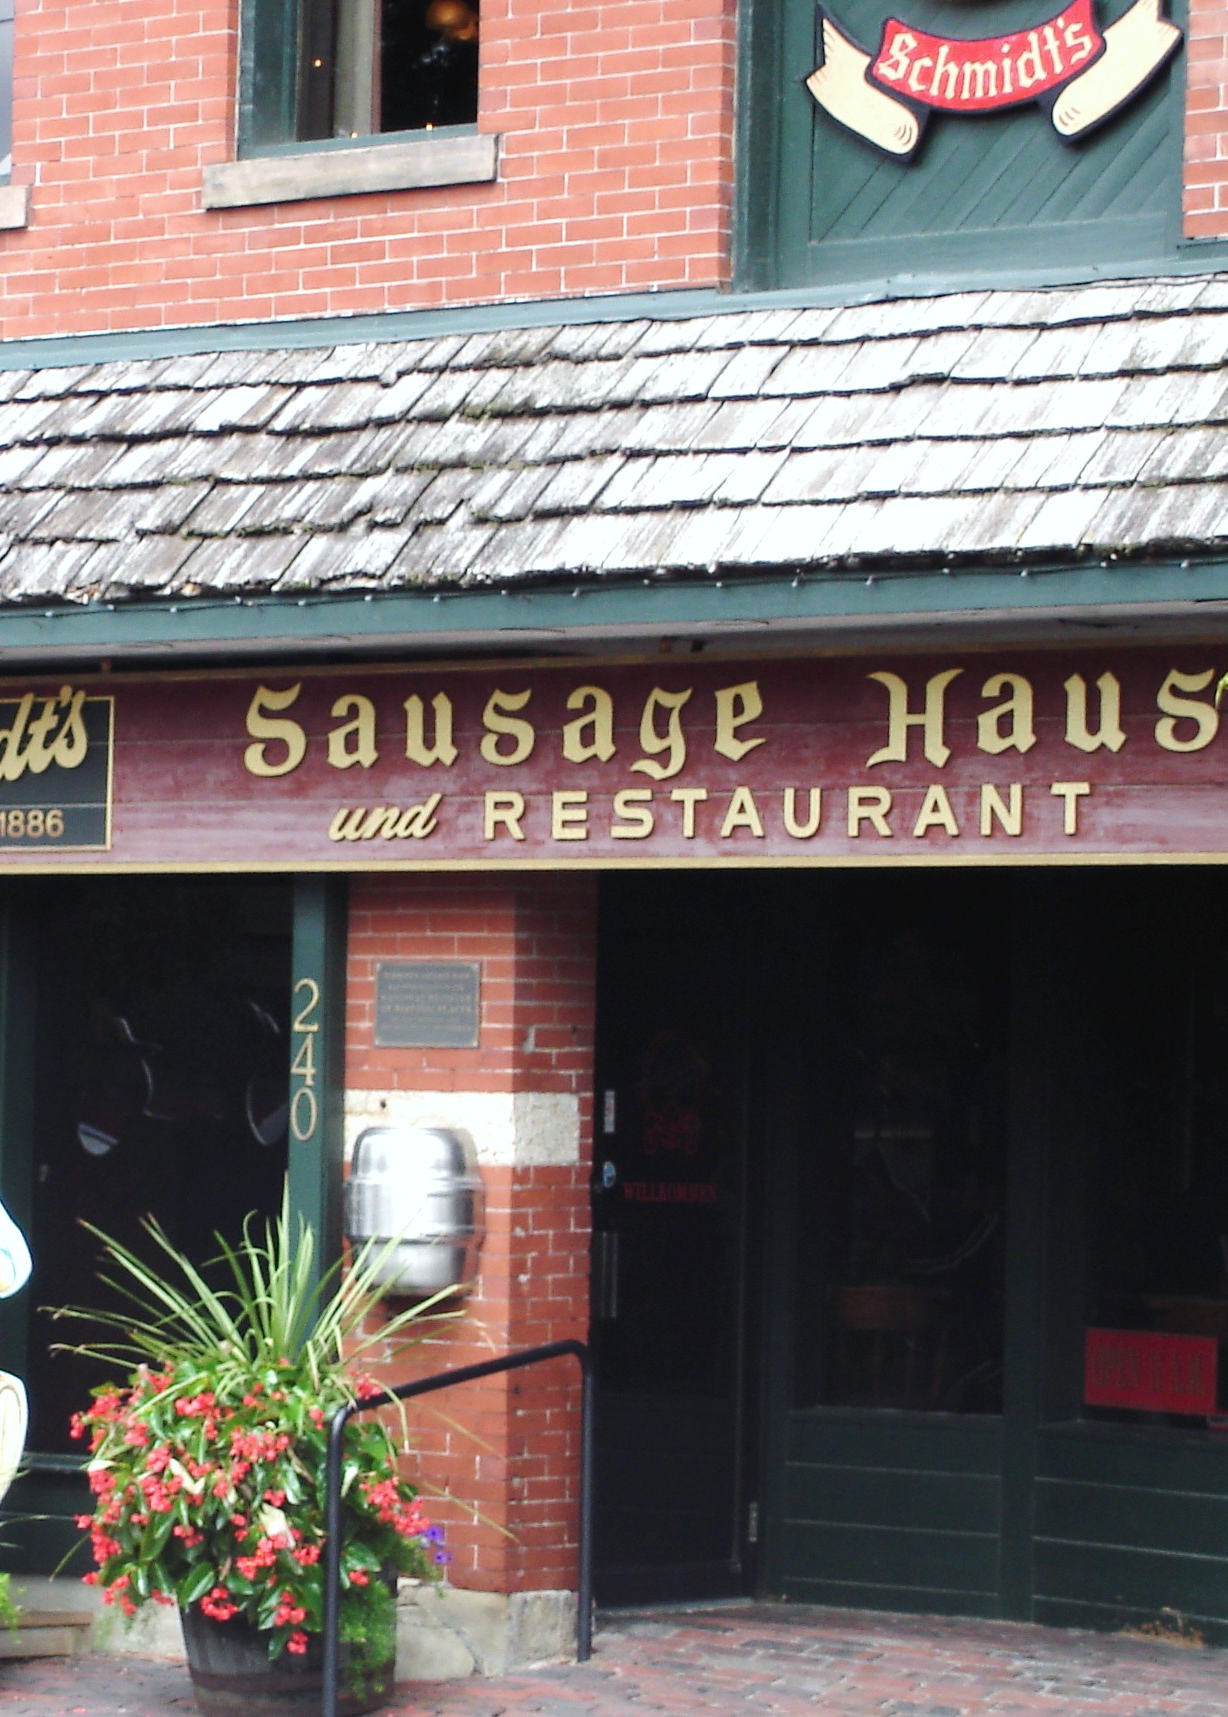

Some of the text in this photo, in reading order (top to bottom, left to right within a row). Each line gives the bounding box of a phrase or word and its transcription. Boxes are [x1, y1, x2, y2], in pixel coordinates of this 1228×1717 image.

[878, 17, 1093, 101] Schmidt's
[244, 668, 1219, 782] Sausage Haus
[329, 781, 1095, 843] und RESTAURANT
[289, 977, 320, 1142] 240
